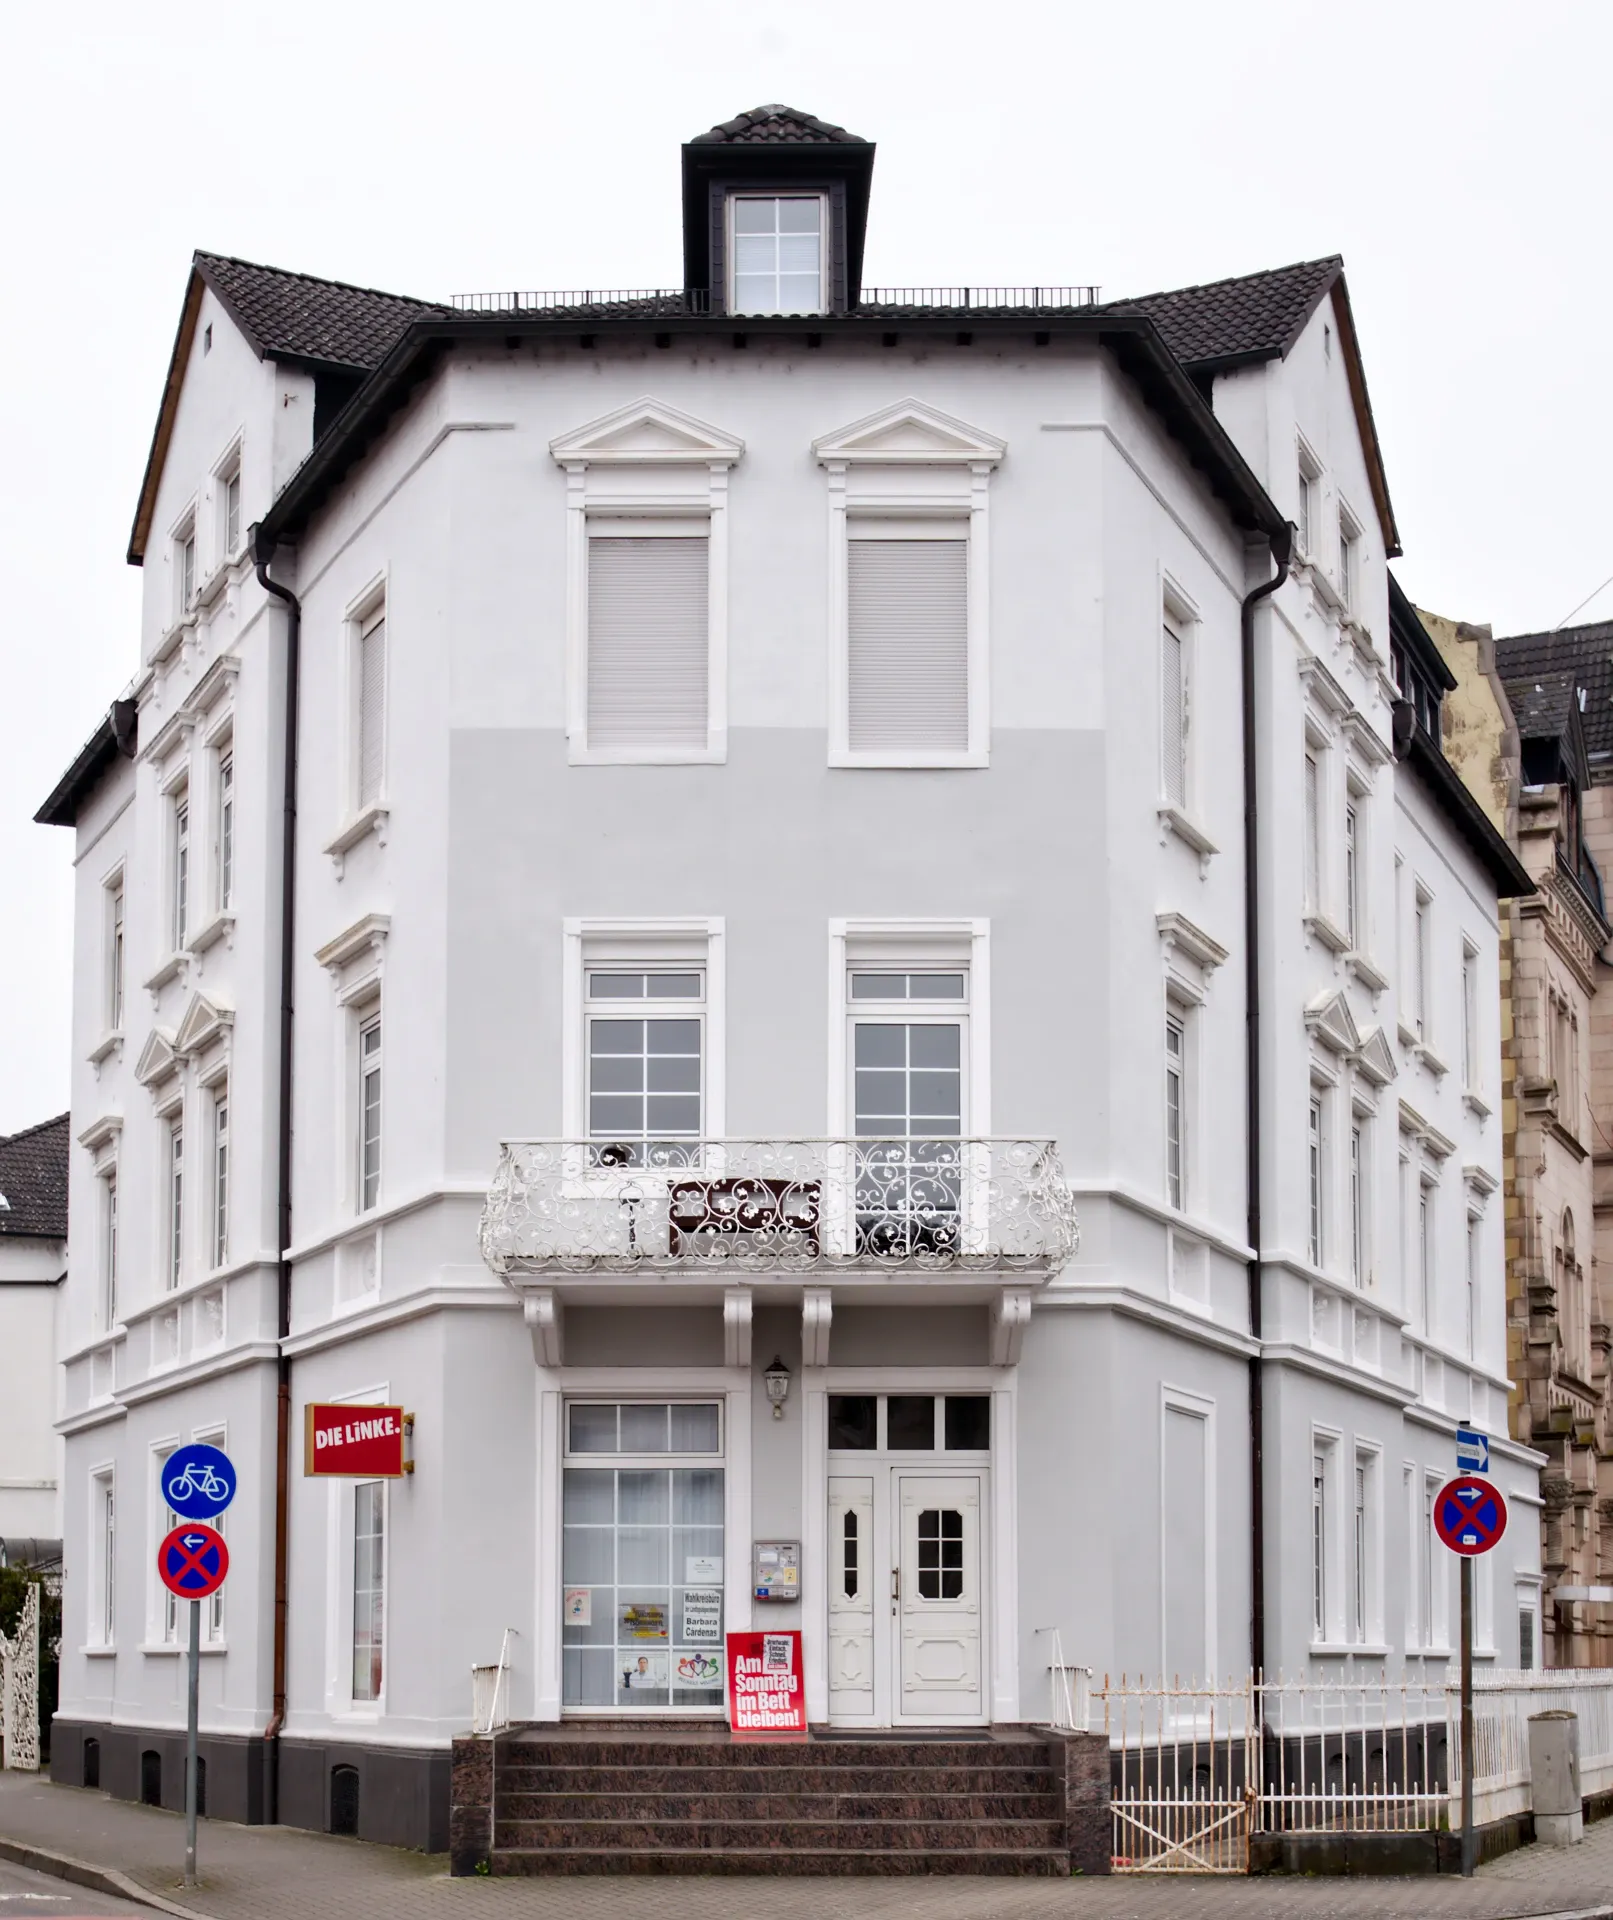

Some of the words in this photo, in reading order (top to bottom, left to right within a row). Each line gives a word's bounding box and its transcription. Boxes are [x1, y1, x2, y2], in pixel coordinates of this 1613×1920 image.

[315, 1426, 343, 1449] DIE
[686, 1617, 718, 1626] Barbara
[686, 1627, 718, 1637] Cárdenas
[735, 1655, 761, 1674] Am
[735, 1673, 797, 1693] Sonntag
[736, 1693, 756, 1711] im
[758, 1691, 790, 1710] Bett
[737, 1709, 800, 1728] bleiben!
